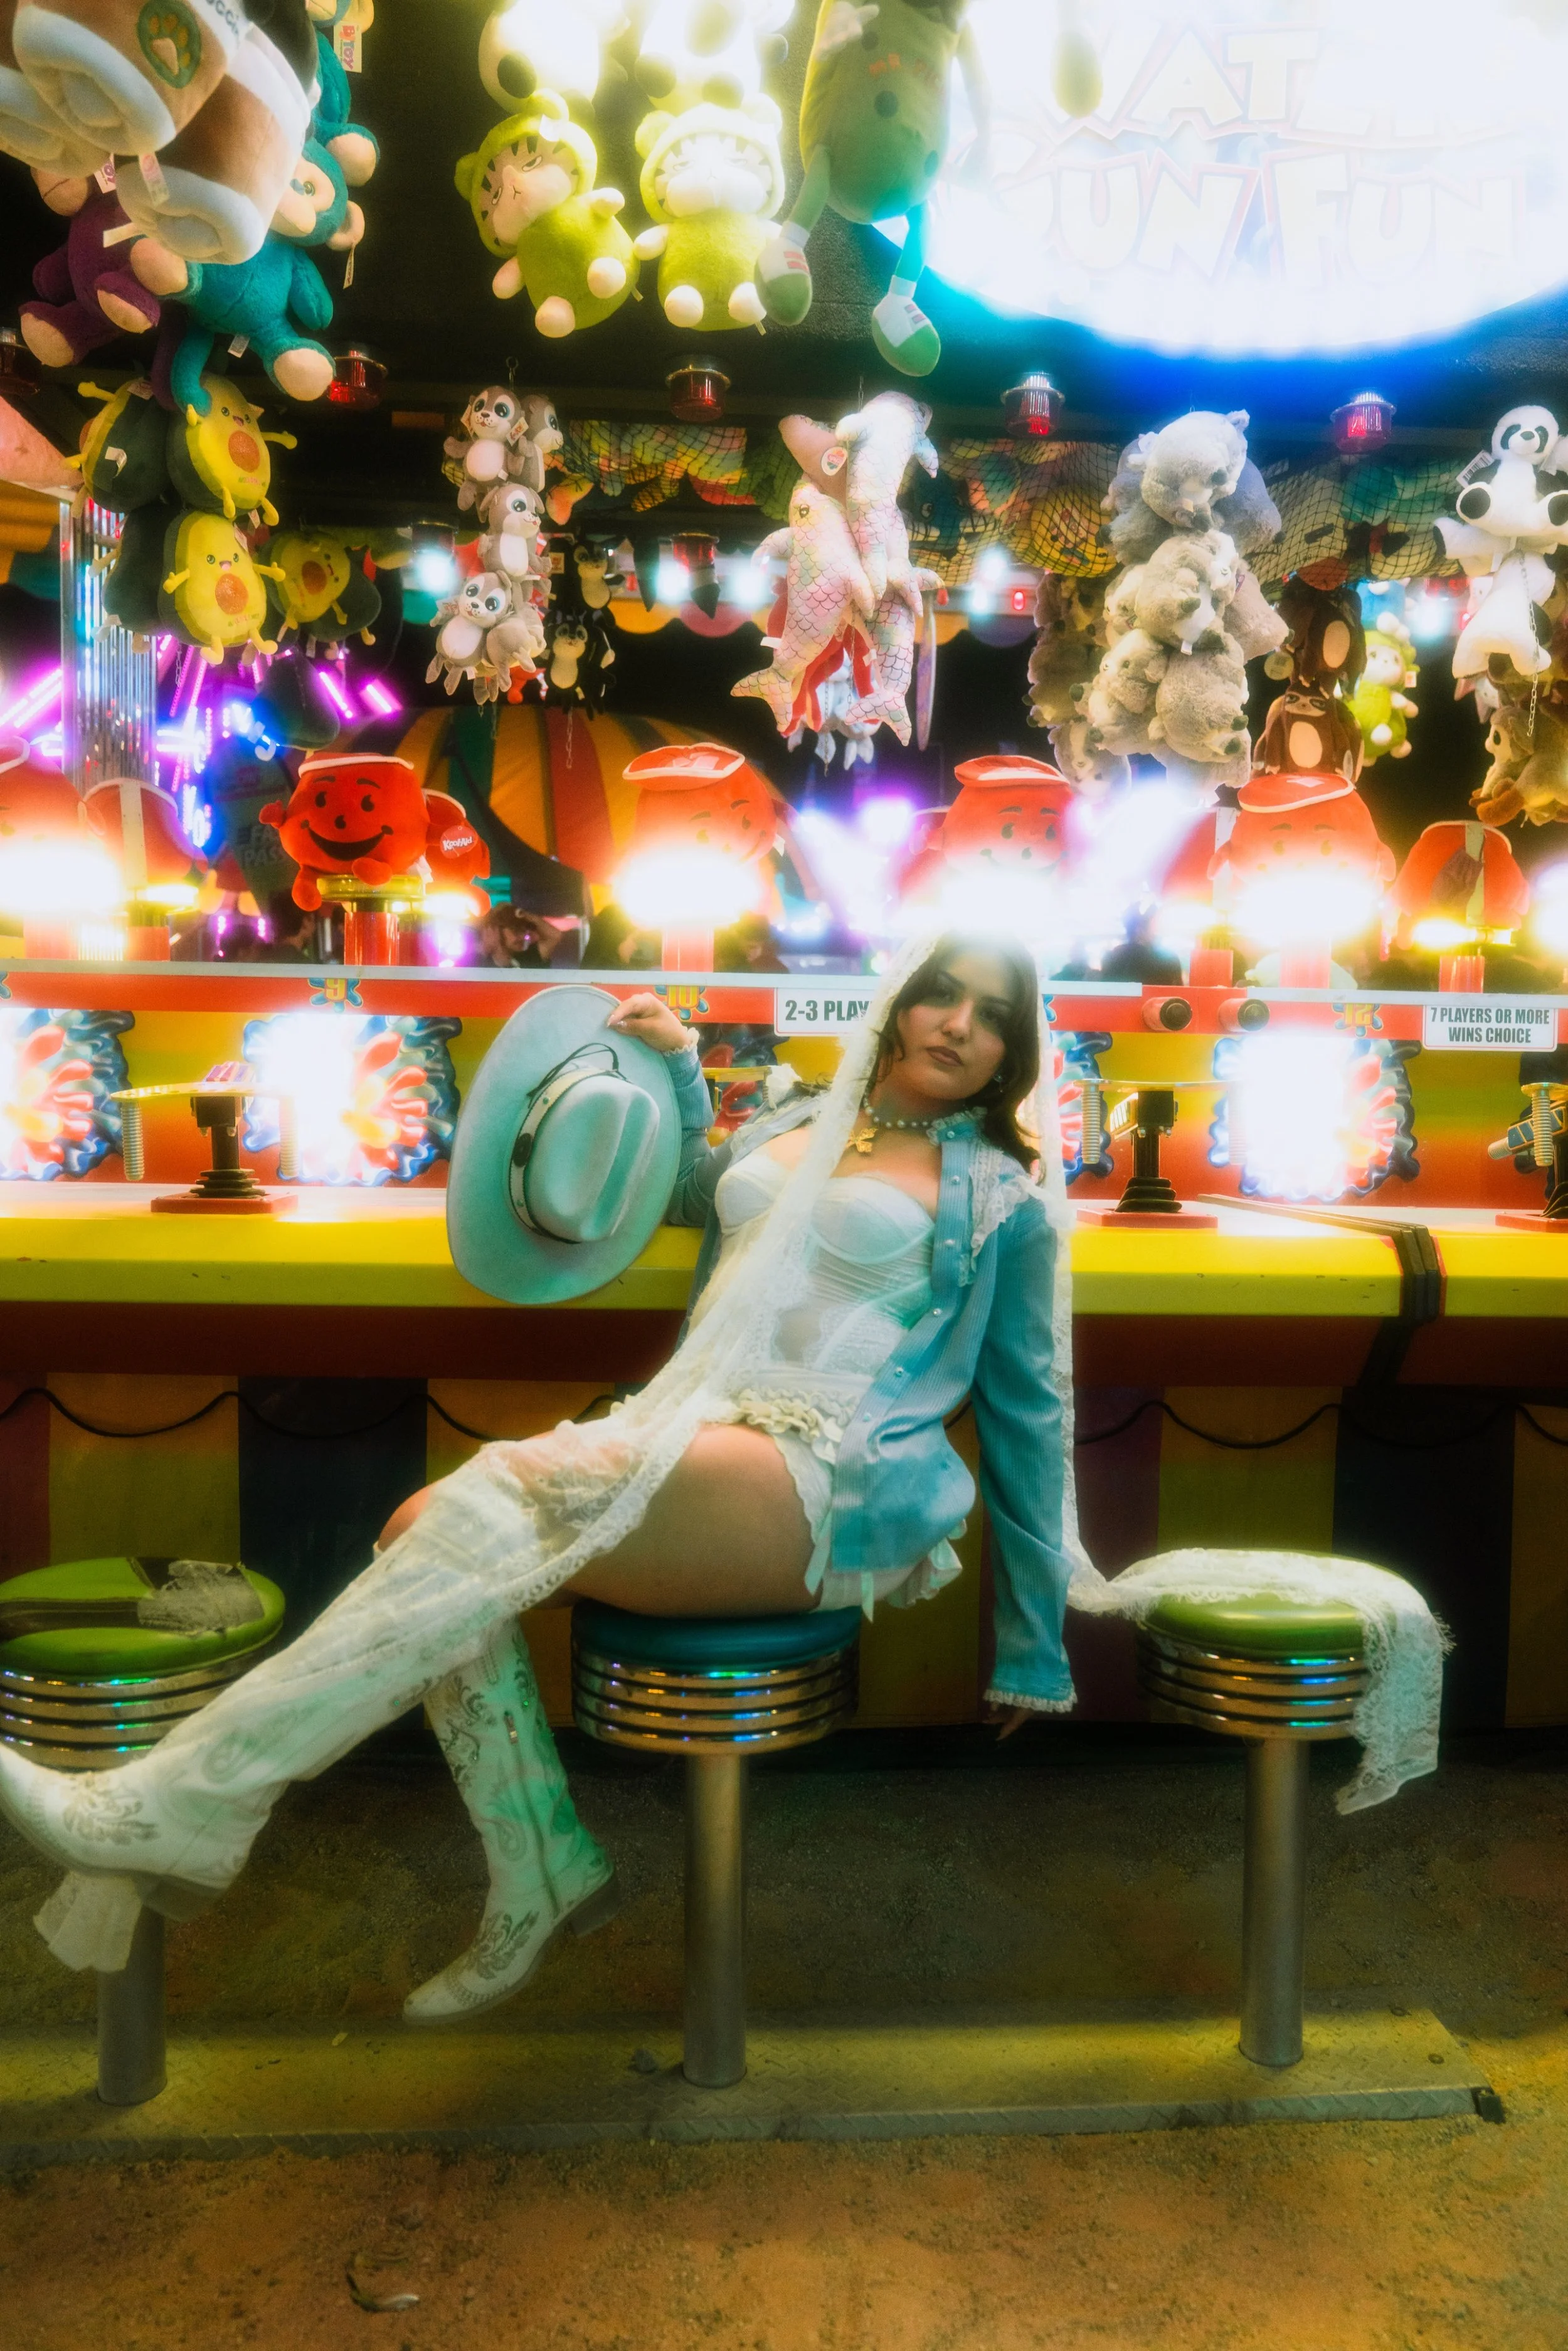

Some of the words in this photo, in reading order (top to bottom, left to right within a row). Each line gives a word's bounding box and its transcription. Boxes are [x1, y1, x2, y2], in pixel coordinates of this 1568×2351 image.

[1273, 154, 1515, 280] FUN
[785, 1000, 818, 1021] 2-3
[824, 1000, 872, 1022] PLAY
[1345, 1003, 1372, 1025] 12
[1431, 1007, 1438, 1022] 7
[1440, 1007, 1492, 1024] PLAYERS
[1495, 1009, 1512, 1024] OR
[1515, 1009, 1550, 1025] MORE
[1449, 1027, 1483, 1043] WINS
[1486, 1028, 1532, 1044] CHOICE
